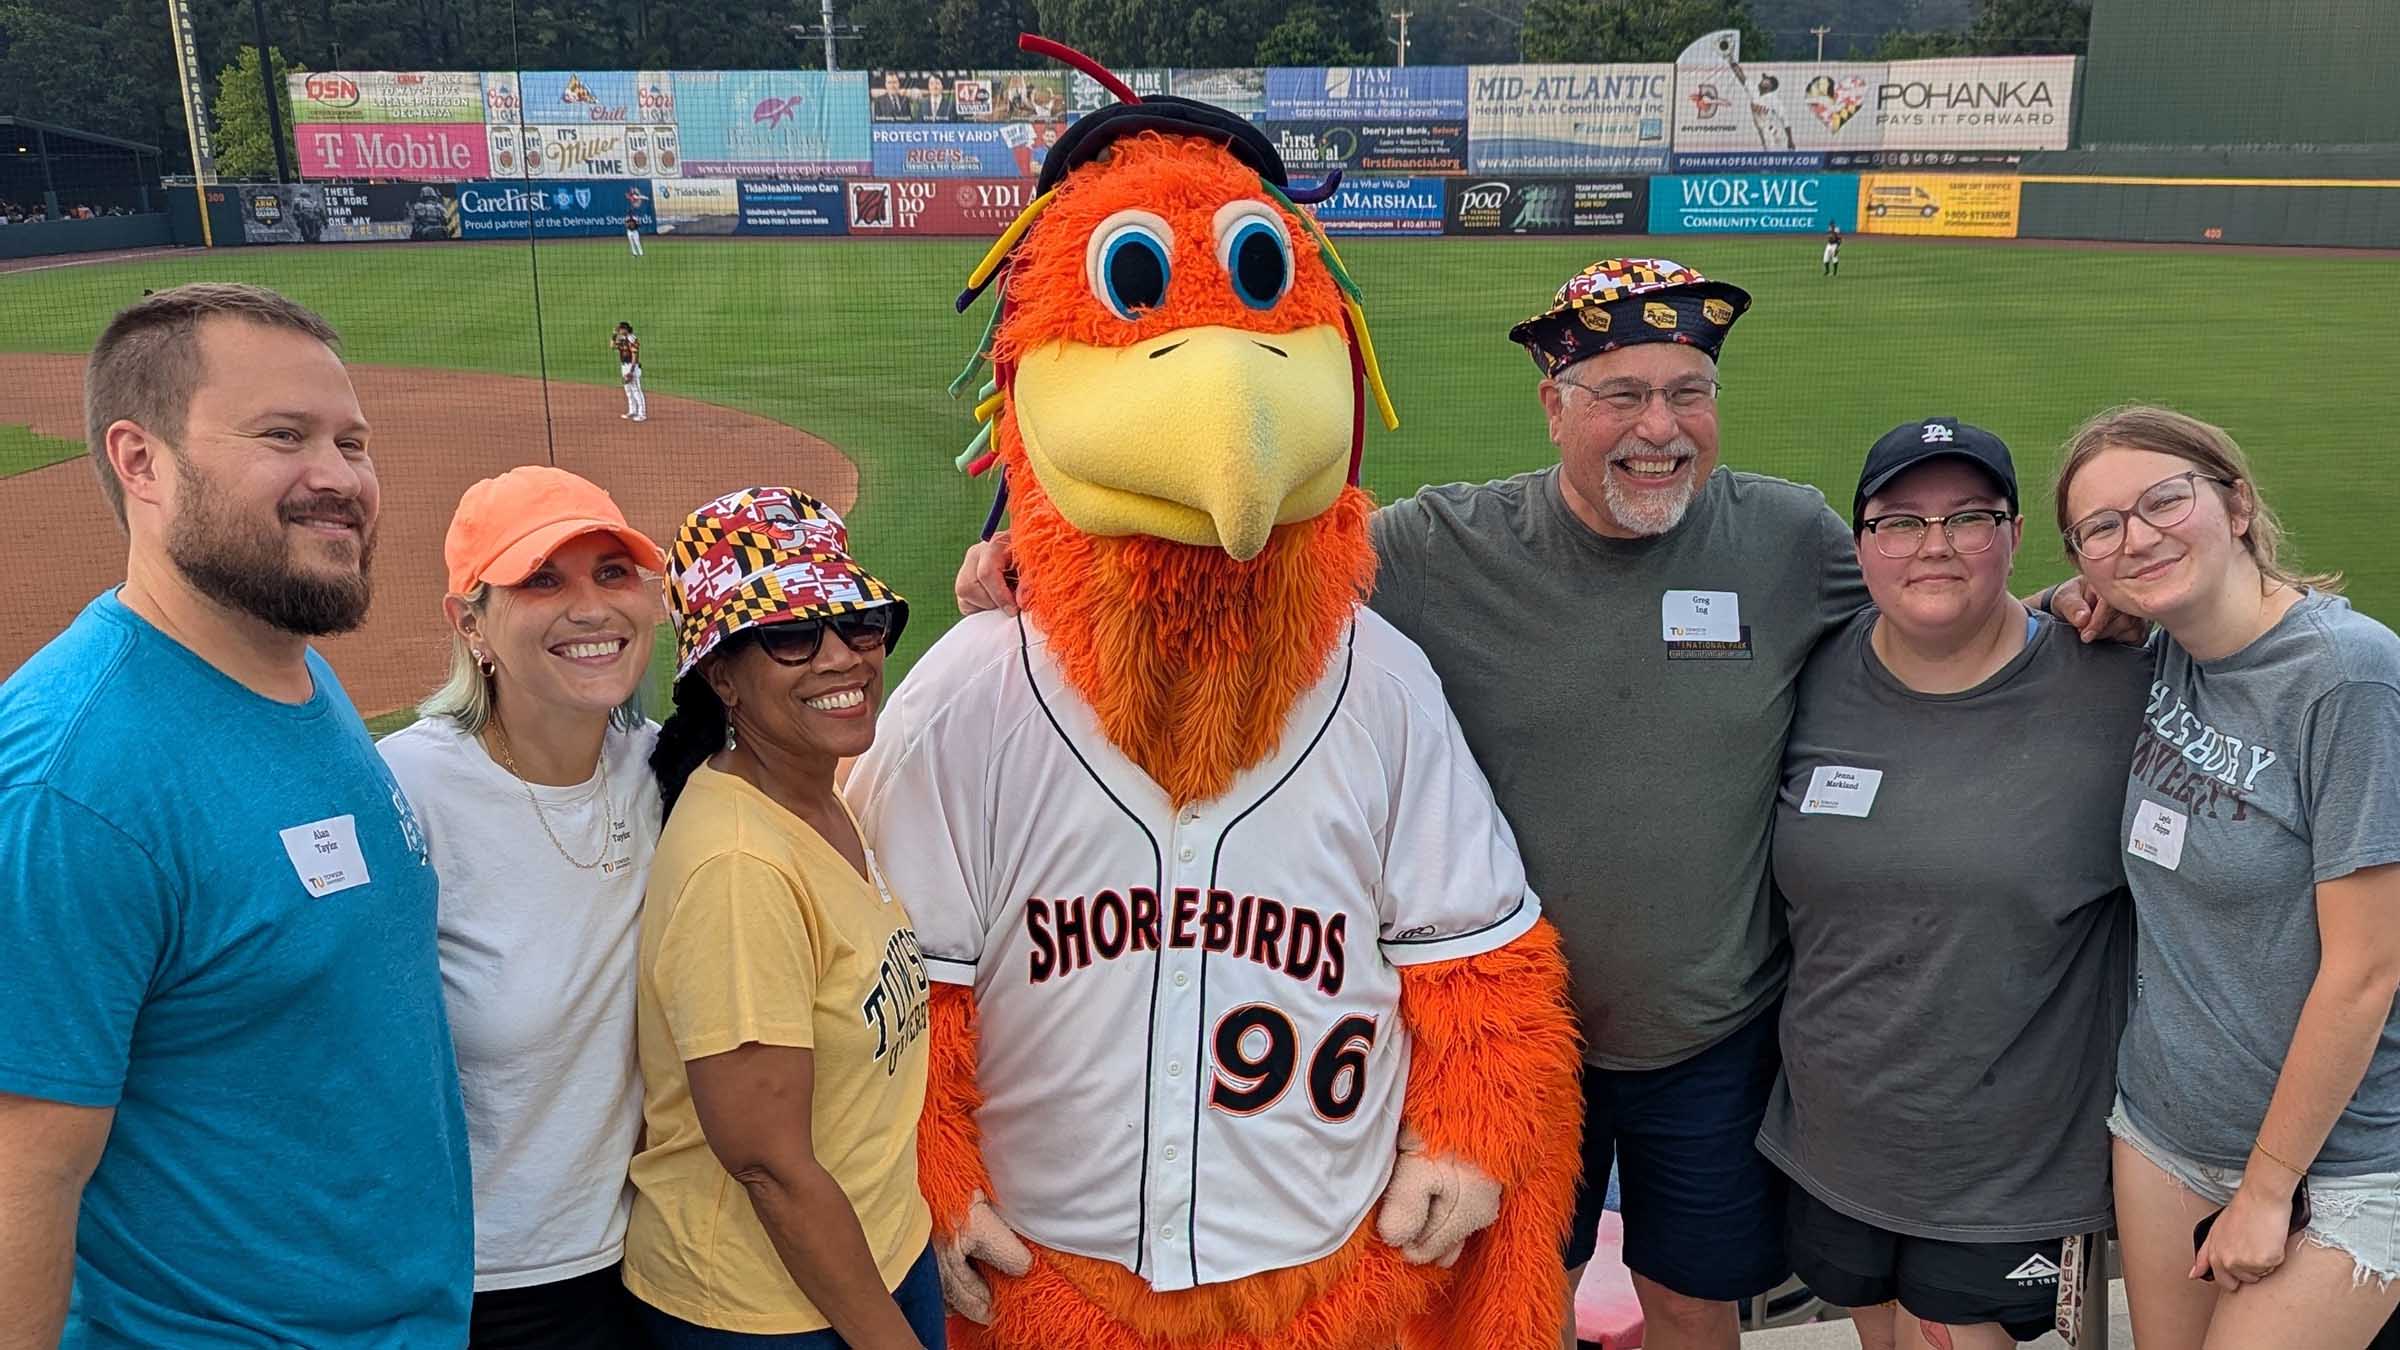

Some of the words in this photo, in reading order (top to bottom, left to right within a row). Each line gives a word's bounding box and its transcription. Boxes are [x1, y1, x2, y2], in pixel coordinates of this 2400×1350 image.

[1136, 73, 1161, 89] ARE
[1355, 68, 1391, 83] PAM
[959, 85, 979, 101] 47
[1355, 85, 1409, 99] HEALTH
[1476, 75, 1665, 101] MID-ATLANTIC
[1877, 81, 2053, 110] POHANKA
[591, 106, 626, 121] Chill
[1476, 104, 1523, 117] Heating
[1539, 103, 1555, 114] Air
[1560, 103, 1642, 115] Conditioning
[1645, 102, 1664, 113] Inc
[1876, 114, 1924, 126] PAYS
[1931, 114, 1947, 124] IT
[1956, 113, 2055, 125] FORWARD
[557, 128, 578, 141] IT'S
[873, 131, 929, 143] PROTECT
[932, 131, 955, 143] THE
[958, 131, 999, 143] YARD?
[1281, 130, 1316, 148] First
[1362, 127, 1385, 135] Don't
[1387, 127, 1404, 137] Just
[315, 133, 344, 169] T
[352, 132, 471, 169] Mobile
[545, 137, 621, 172] Miller
[585, 160, 623, 175] TIME
[1362, 157, 1460, 169] firstfinancial.org
[1679, 155, 1819, 167] POHANKAOFSALISBURY.COM
[324, 187, 355, 196] THERE
[793, 183, 817, 193] Home
[818, 183, 839, 193] Care
[896, 183, 936, 198] YOU
[1360, 180, 1380, 189] What
[1382, 180, 1394, 189] We
[977, 185, 1019, 207] YDI
[1681, 178, 1819, 206] WOR-WIC
[255, 200, 277, 208] ARMY
[326, 197, 338, 205] IS
[344, 197, 368, 205] MORE
[461, 188, 549, 213] CareFirst
[898, 199, 925, 213] DO
[1342, 192, 1437, 209] MARSHALL
[1460, 191, 1502, 215] poa
[327, 207, 352, 215] THAN
[329, 217, 349, 225] ONE
[352, 217, 371, 225] WAY
[465, 220, 493, 230] Proud
[495, 220, 529, 232] partner
[536, 218, 545, 227] of
[546, 217, 562, 227] the
[563, 216, 604, 227] Delmarva
[606, 215, 652, 226] Shorrds
[899, 213, 917, 228] IT
[1683, 215, 1759, 228] COMMUNITY
[1760, 215, 1815, 228] COLLEGE
[1921, 423, 1953, 443] LA
[1692, 596, 1710, 605] Greg
[1670, 627, 1684, 636] TU
[313, 829, 330, 840] Alan
[2134, 838, 2144, 851] TU
[602, 863, 614, 873] TU
[308, 877, 324, 888] TU
[1026, 887, 1346, 997] SHOREBIRDS
[1207, 1001, 1379, 1124] 96
